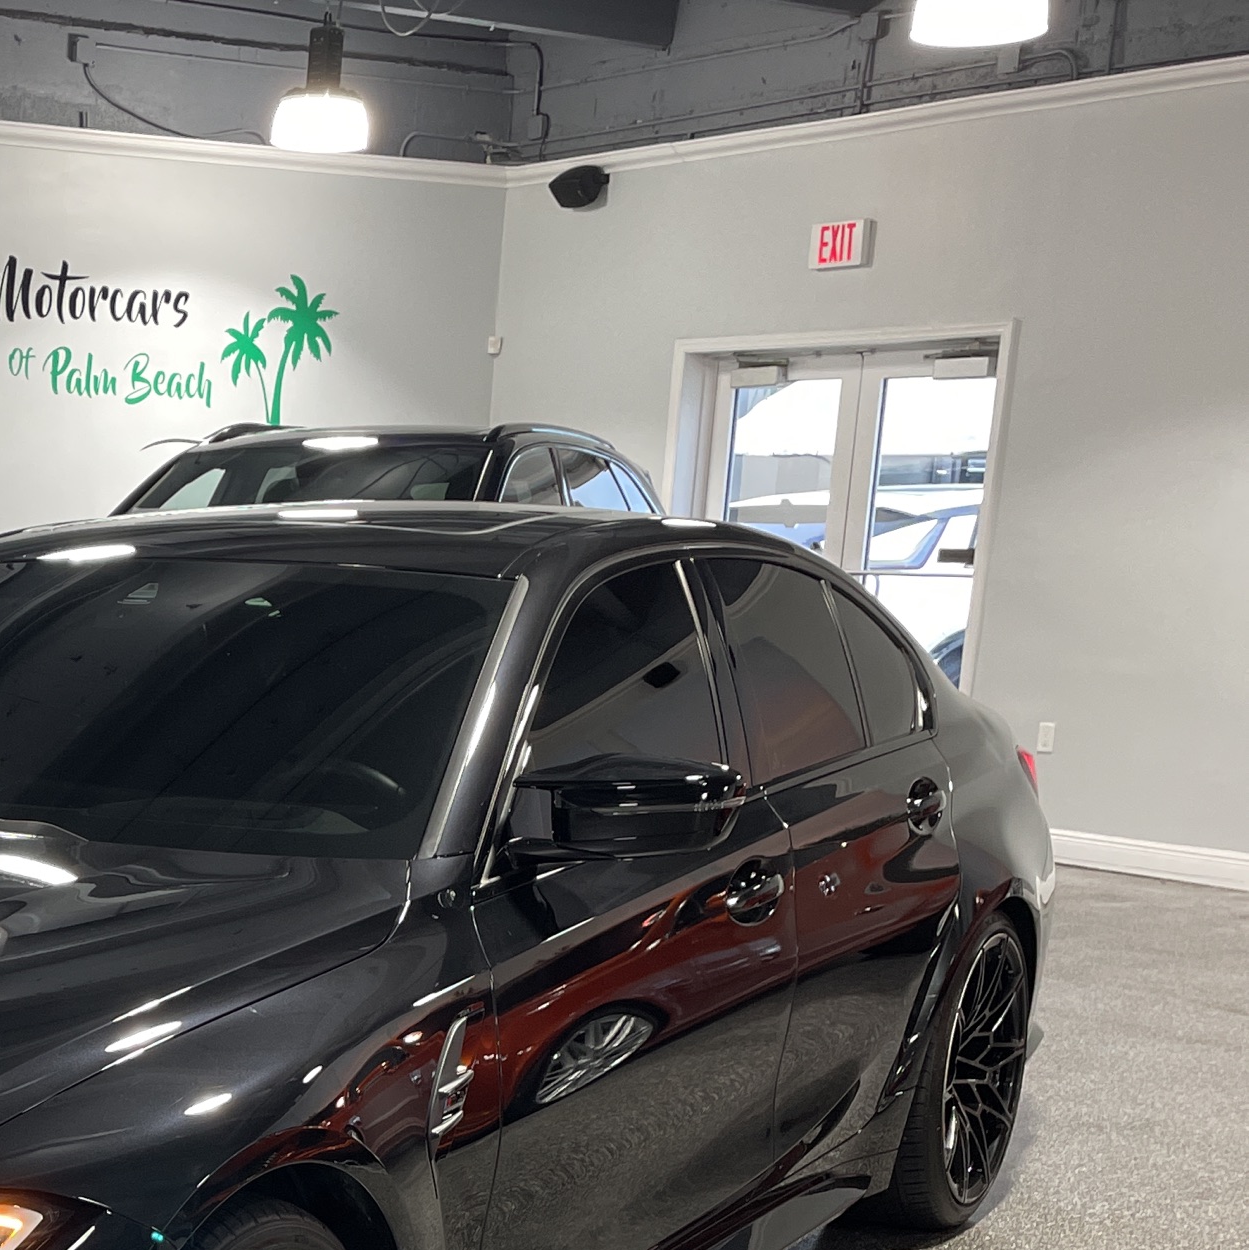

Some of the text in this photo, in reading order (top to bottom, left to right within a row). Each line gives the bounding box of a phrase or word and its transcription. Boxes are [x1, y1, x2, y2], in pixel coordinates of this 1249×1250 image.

[818, 222, 856, 264] EXIT
[8, 346, 212, 408] Of Palm Beach
